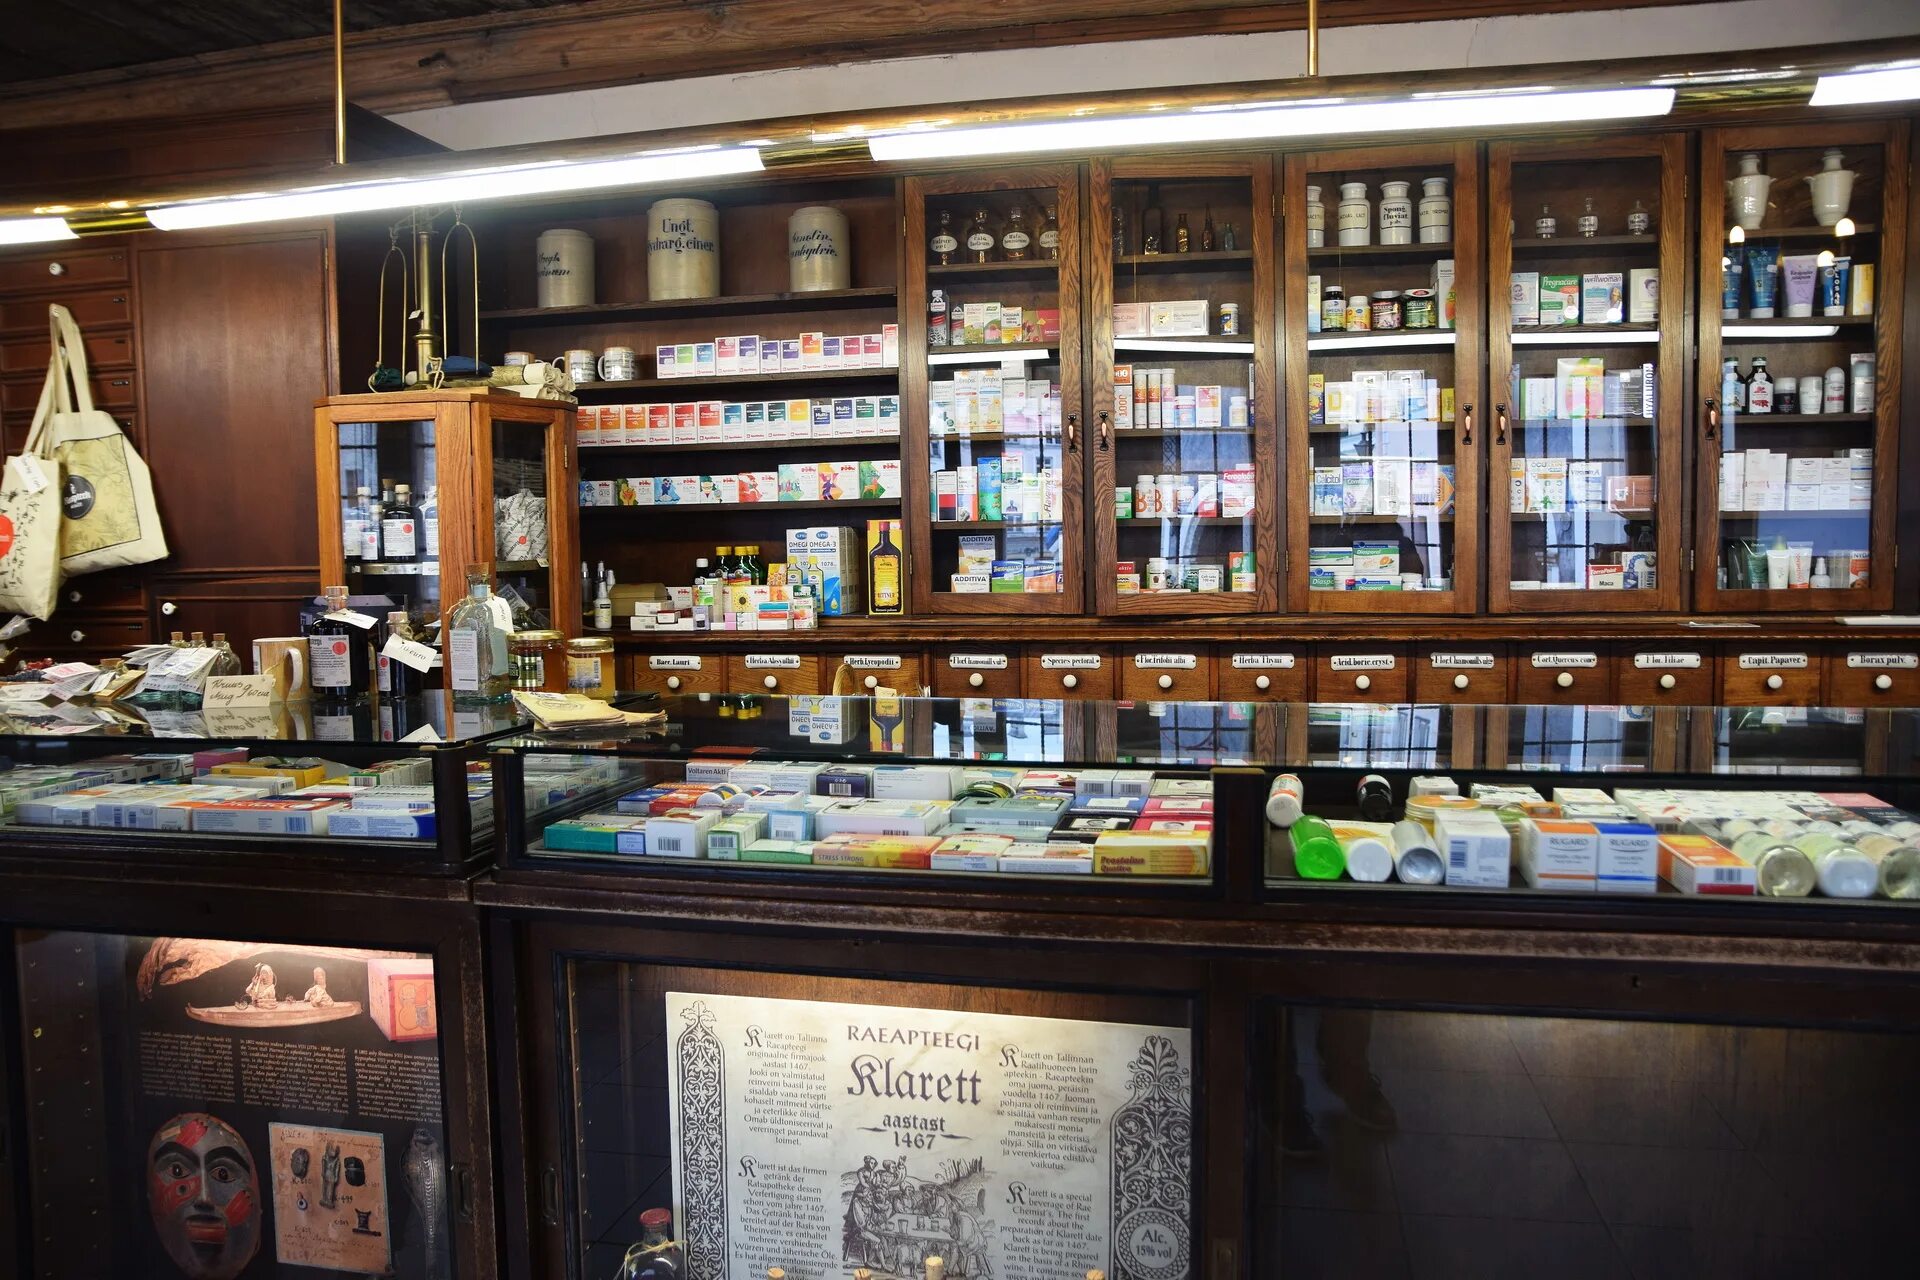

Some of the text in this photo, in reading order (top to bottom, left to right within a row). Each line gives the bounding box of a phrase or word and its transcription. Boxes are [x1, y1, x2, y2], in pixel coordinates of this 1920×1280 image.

[1542, 276, 1577, 288] Pregnacare
[1860, 655, 1884, 664] Borax
[847, 1025, 980, 1052] RAEAPTEEGI
[847, 1054, 982, 1106] Klarett
[744, 1114, 767, 1123] Omab
[882, 1114, 946, 1132] aastast
[894, 1131, 936, 1150] 1467
[789, 1164, 800, 1172] das
[793, 1174, 804, 1182] der
[1072, 1222, 1084, 1230] the
[1142, 1229, 1167, 1244] Alc.
[1136, 1244, 1171, 1258] 15% vol
